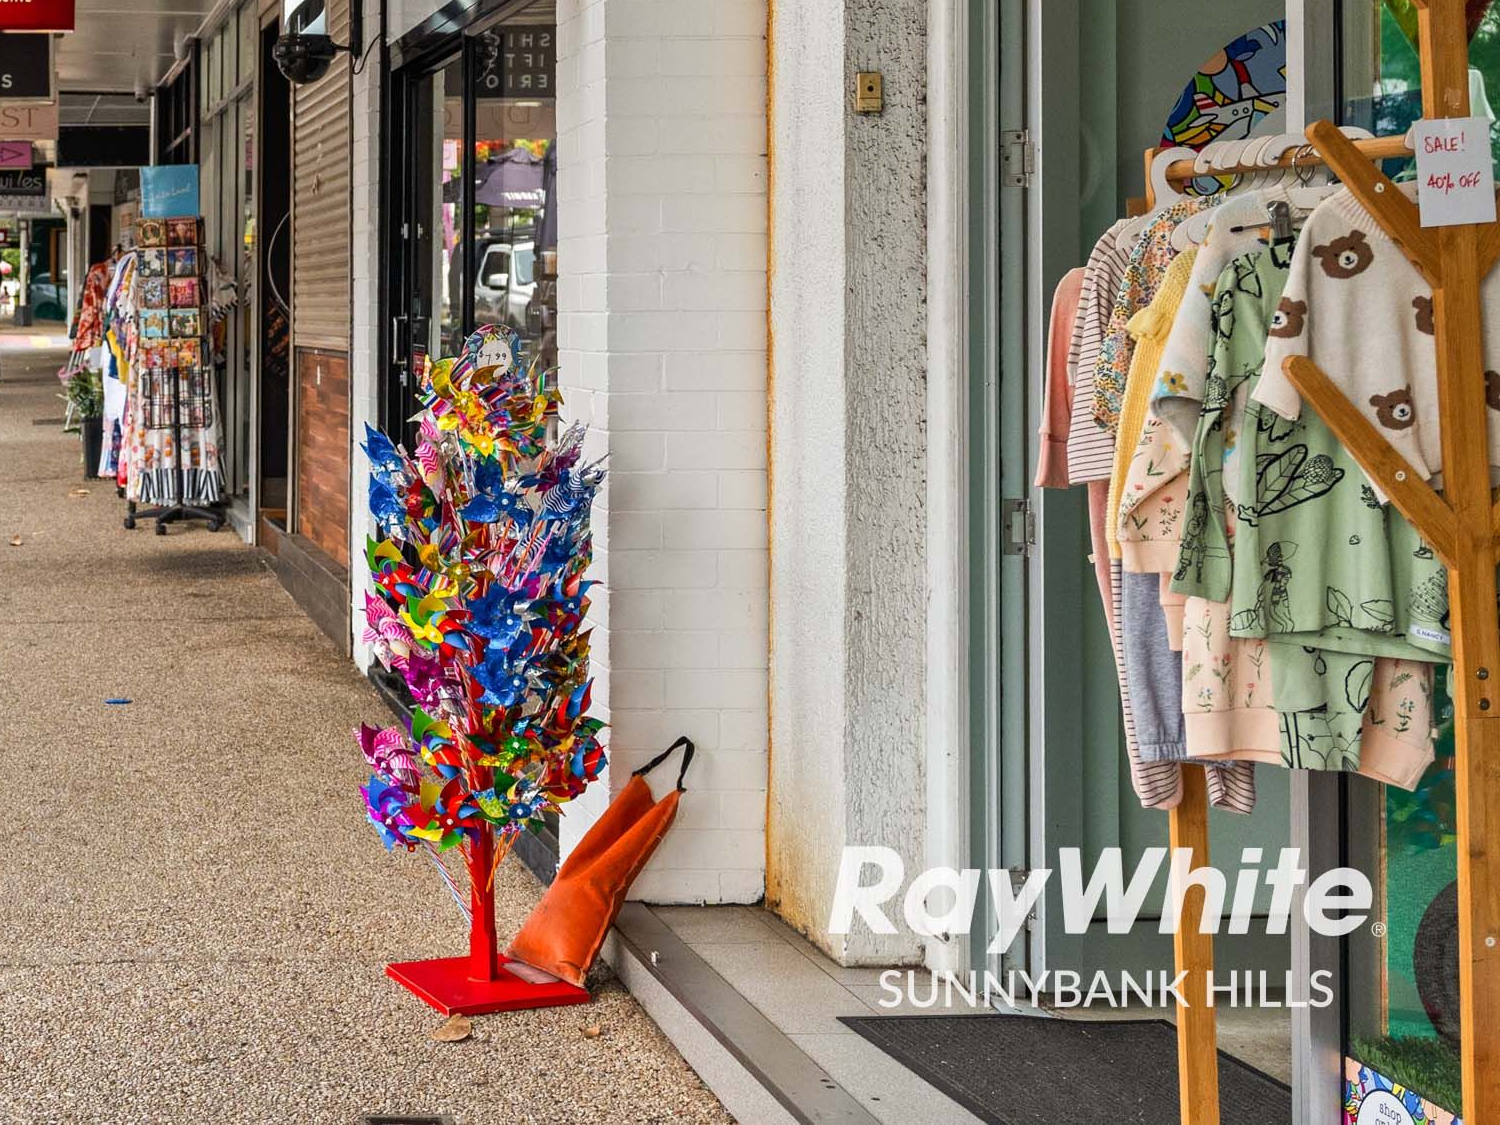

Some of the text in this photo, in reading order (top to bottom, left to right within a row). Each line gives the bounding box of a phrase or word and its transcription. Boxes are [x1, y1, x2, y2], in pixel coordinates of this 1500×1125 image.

[1424, 131, 1465, 154] SALE!
[1427, 171, 1481, 196] 40% OFF
